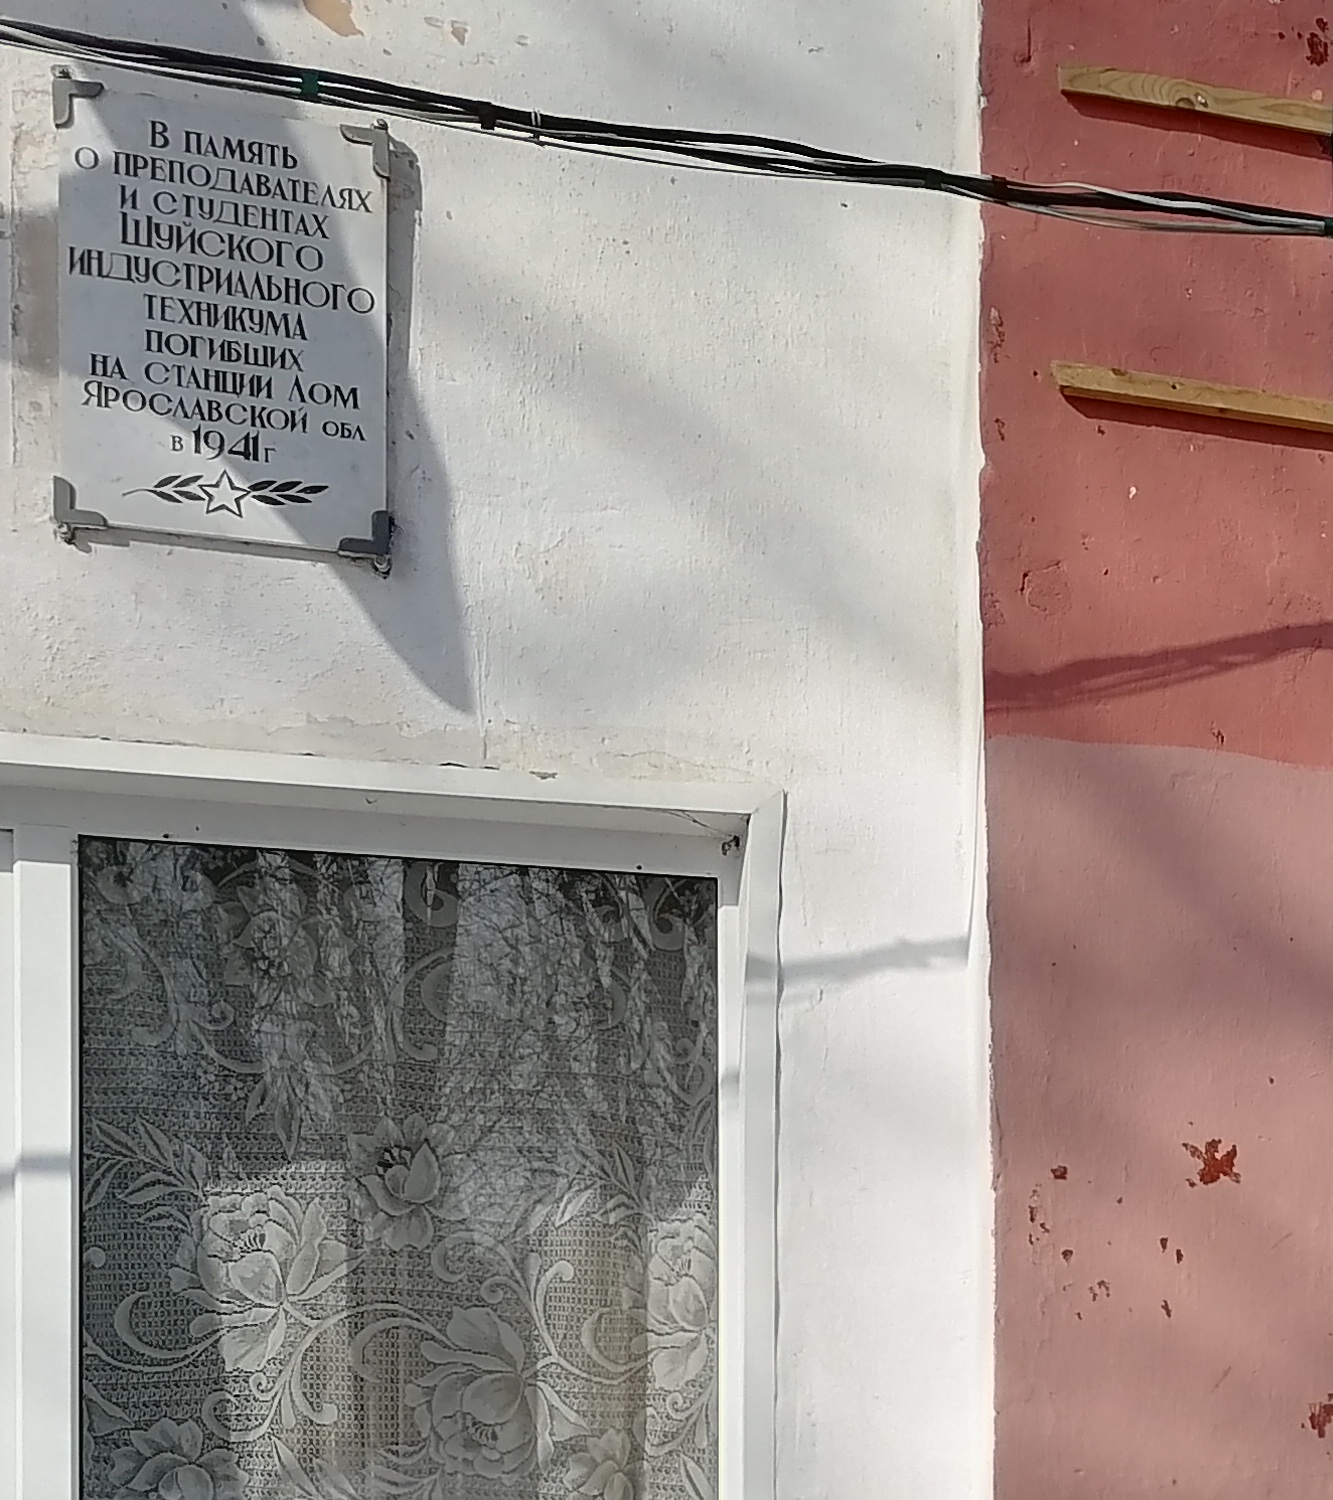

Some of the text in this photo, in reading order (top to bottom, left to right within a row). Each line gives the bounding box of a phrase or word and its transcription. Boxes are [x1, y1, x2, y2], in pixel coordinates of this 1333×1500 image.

[149, 120, 298, 170] В ПАМЯТЬ
[74, 147, 373, 213] О ПРЕПОДАВАТЕЛЯХ
[119, 184, 330, 239] И СТУДЕНТАХ
[119, 212, 323, 273] ШУЙСКОГО
[67, 246, 376, 315] ИНДУСТРИАЛЬНОГО
[143, 293, 308, 341] ТЕХНИКУМА
[145, 330, 305, 372] ПОГИБШИХ
[81, 380, 309, 434] ЯРОСЛАВСКОЙ
[89, 353, 361, 410] НА СТАНЦИИ ЛОМ
